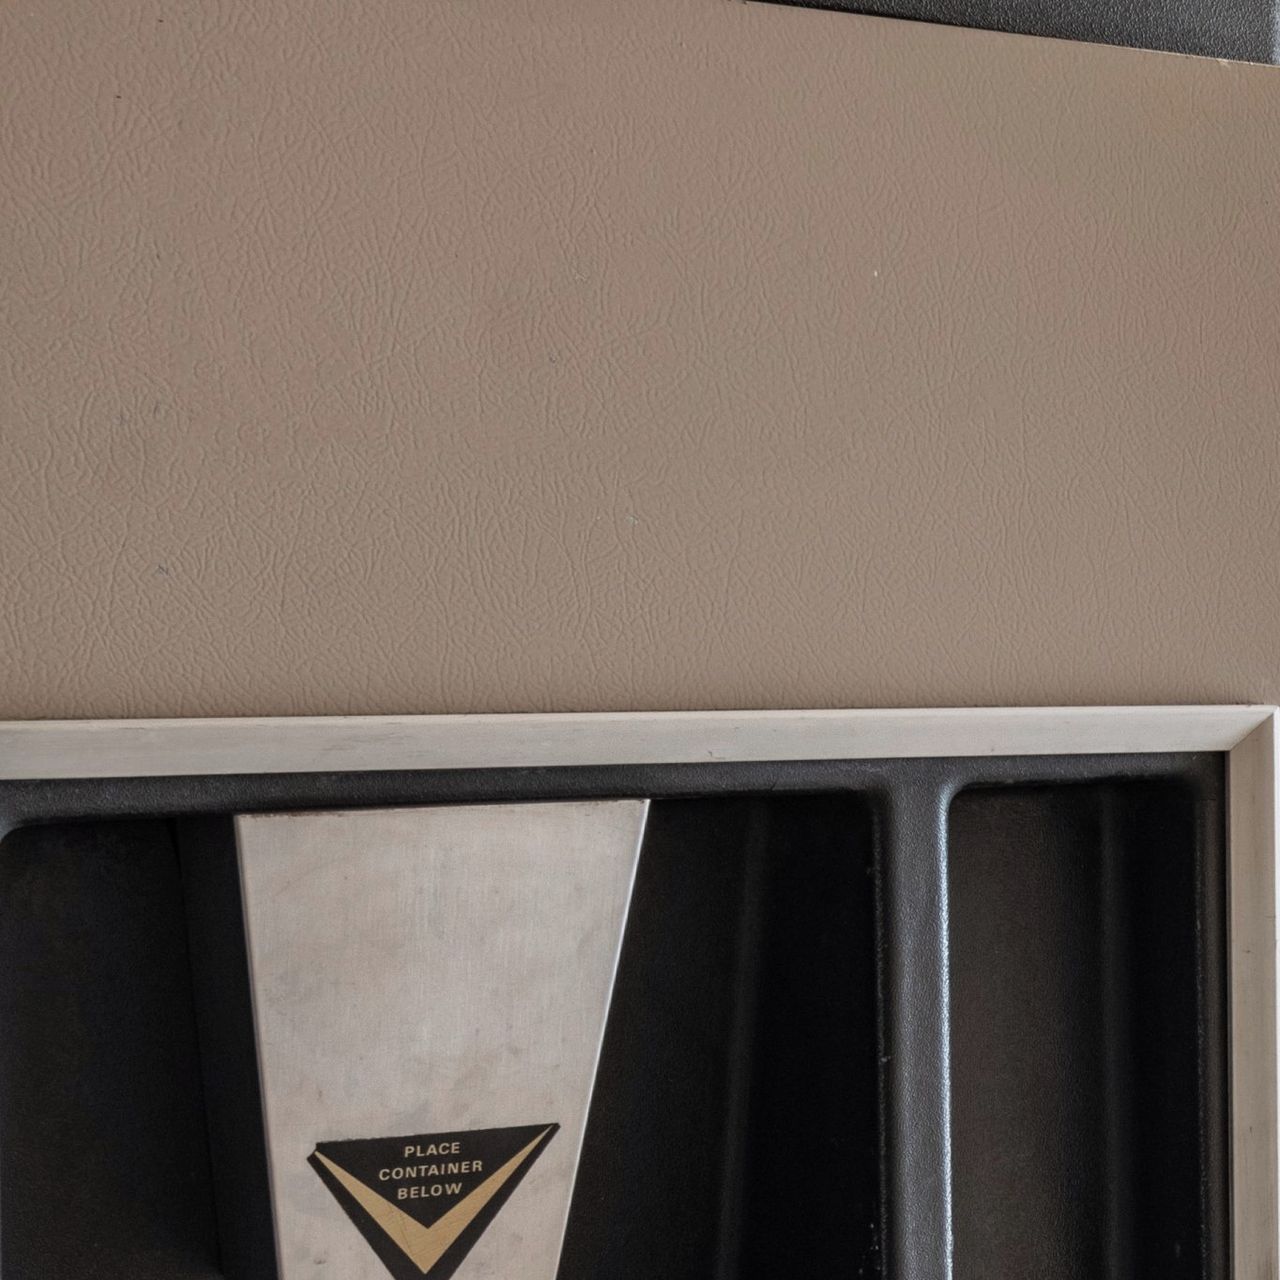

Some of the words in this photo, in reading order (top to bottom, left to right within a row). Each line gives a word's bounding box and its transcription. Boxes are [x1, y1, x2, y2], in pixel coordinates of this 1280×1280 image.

[404, 1142, 460, 1158] PLACE
[379, 1160, 482, 1180] CONTAINER
[398, 1182, 462, 1200] BELOW
